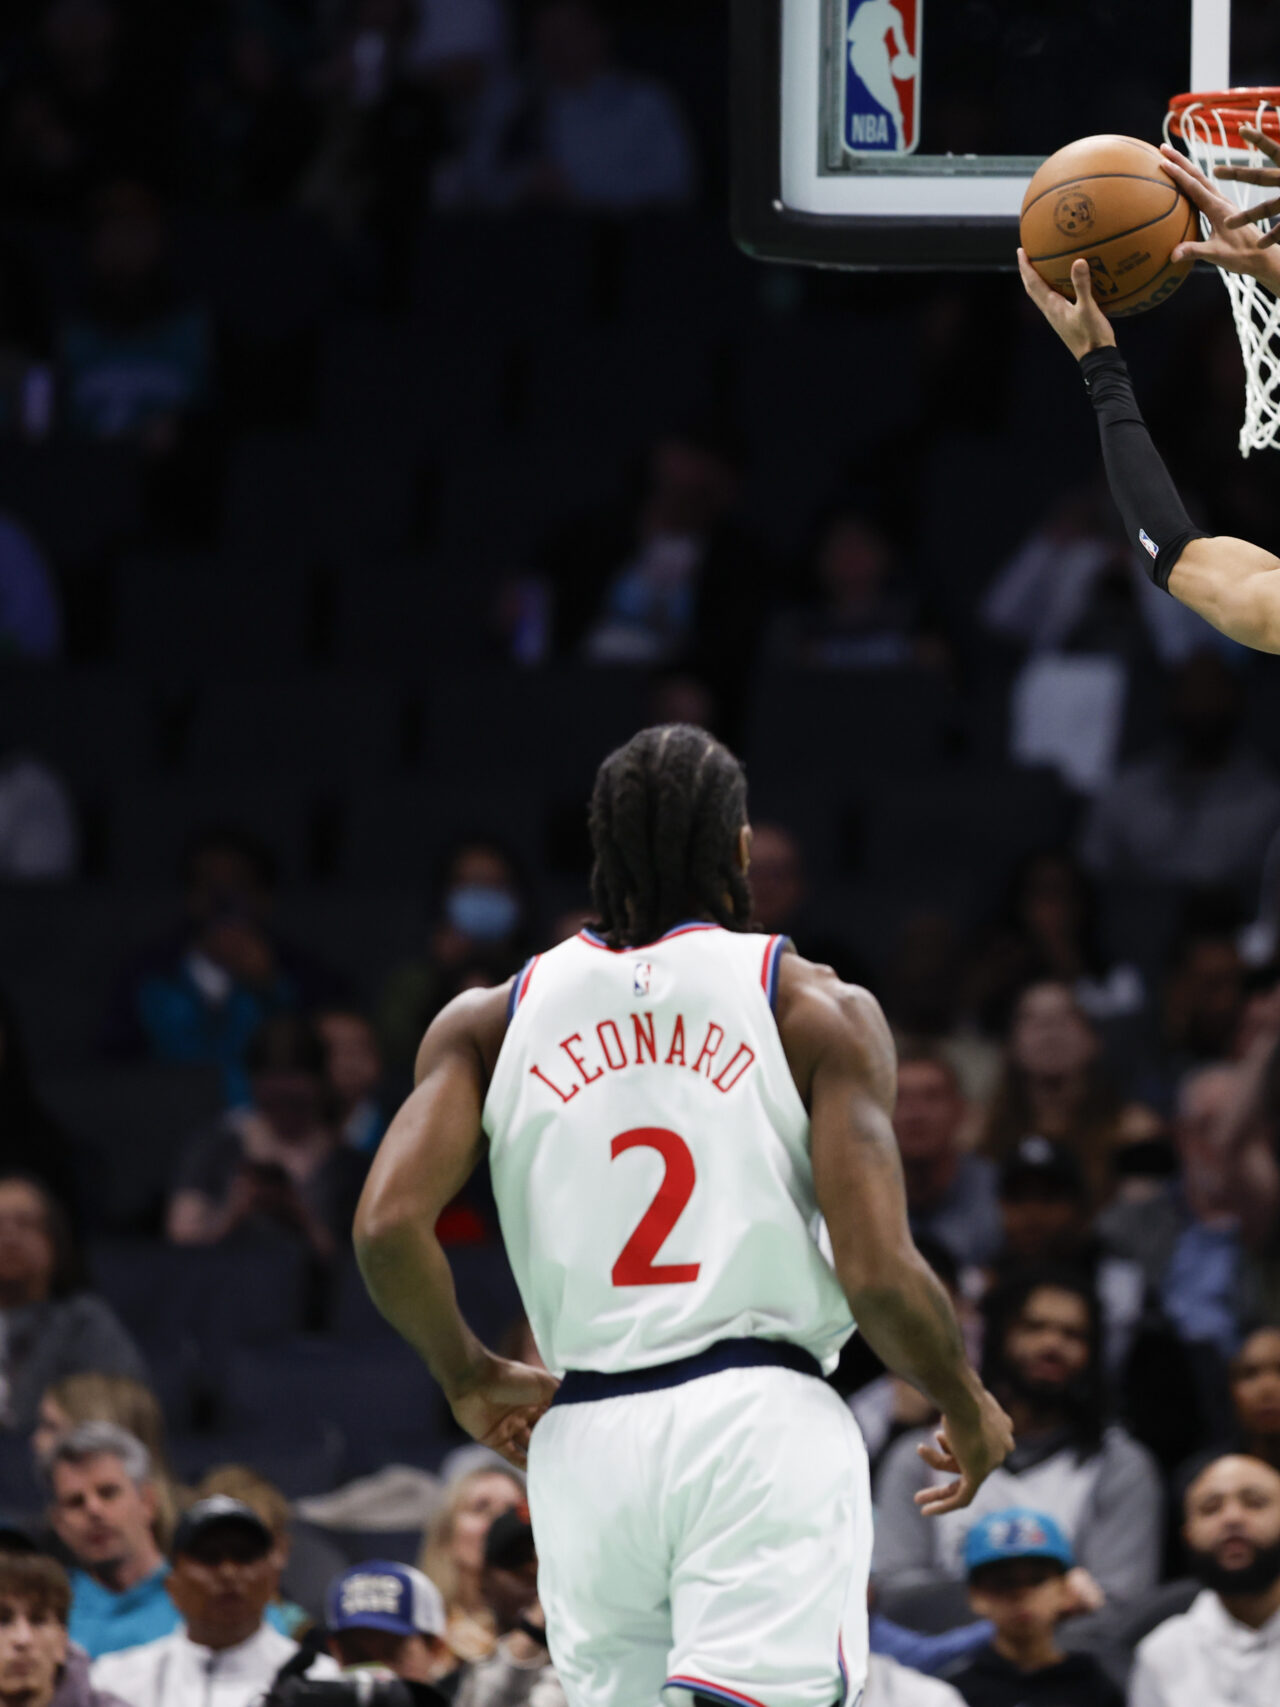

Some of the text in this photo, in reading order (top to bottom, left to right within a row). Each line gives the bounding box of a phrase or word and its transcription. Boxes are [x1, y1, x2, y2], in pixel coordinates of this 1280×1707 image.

[851, 113, 889, 144] NBA
[530, 1011, 756, 1103] LEONARD
[610, 1126, 701, 1286] 2
